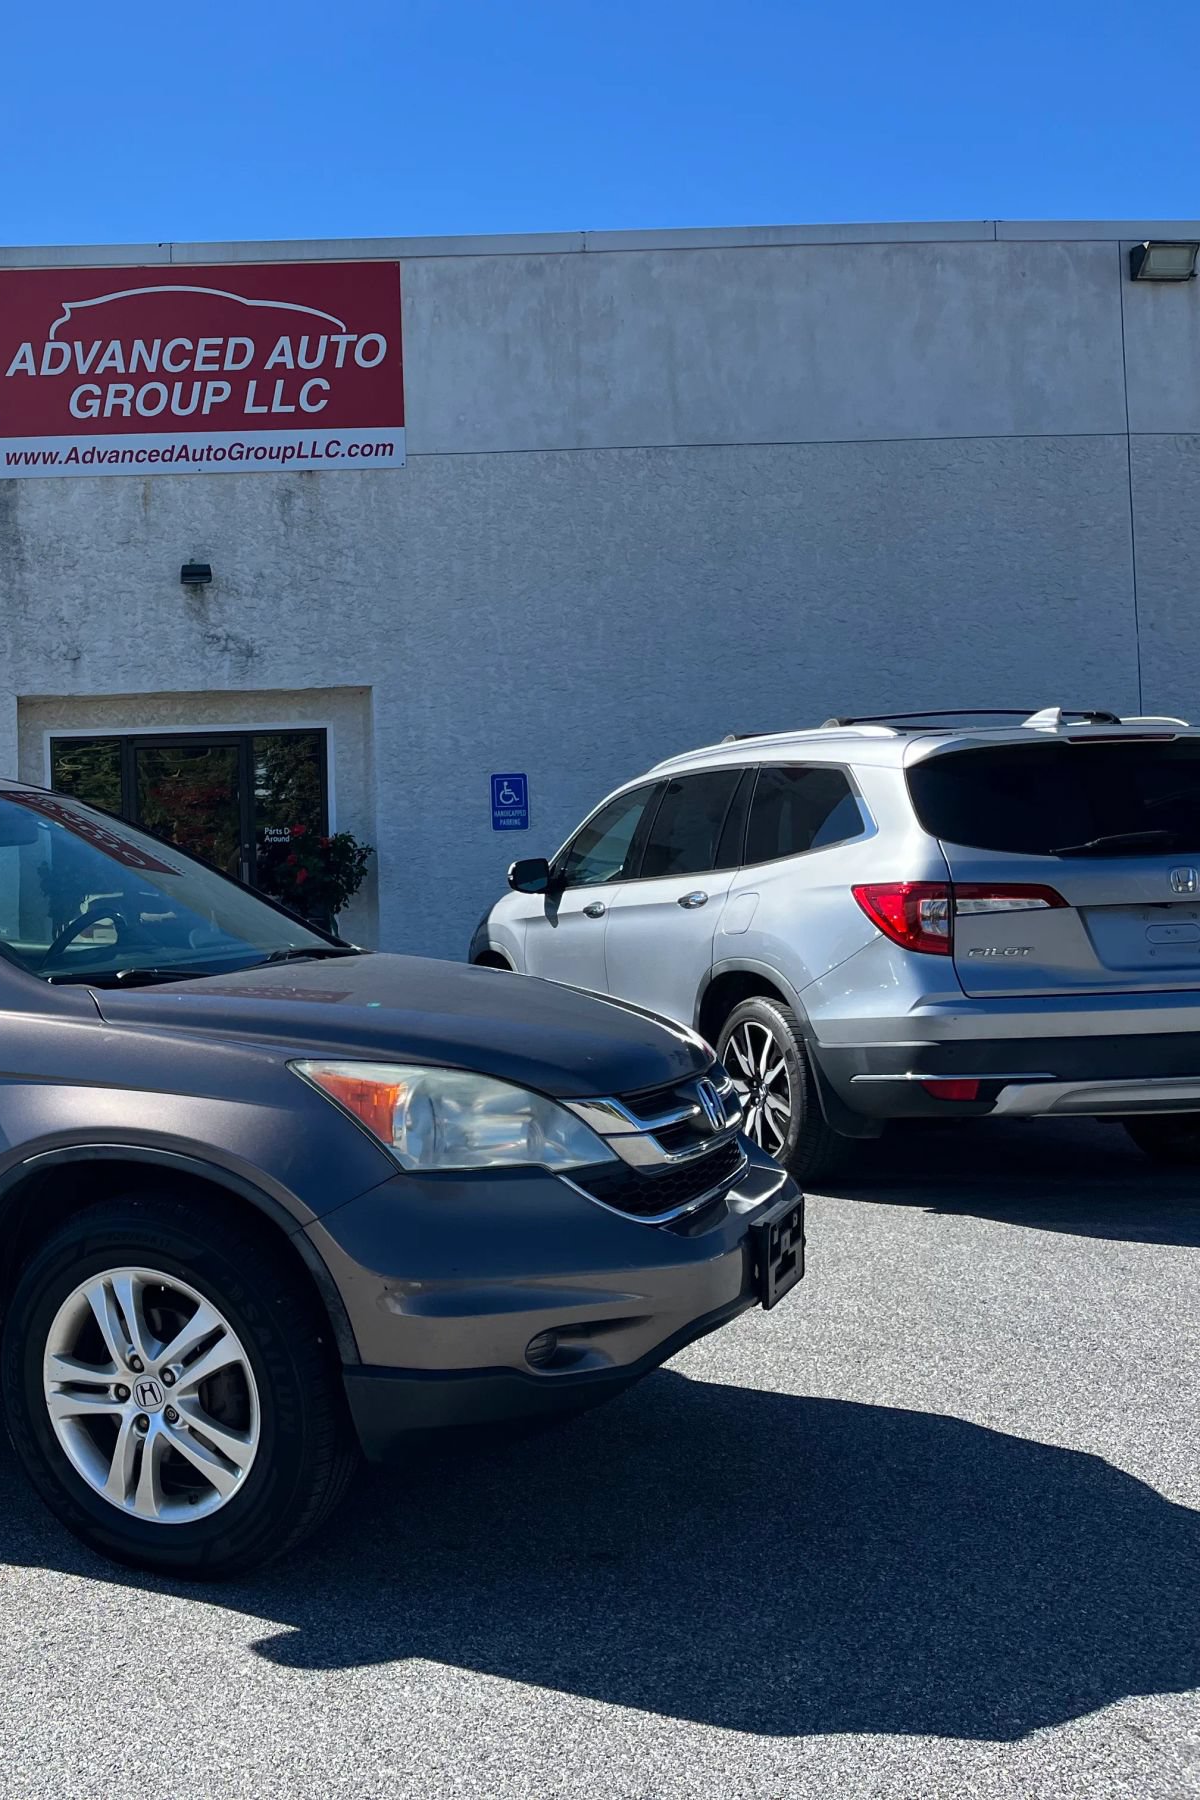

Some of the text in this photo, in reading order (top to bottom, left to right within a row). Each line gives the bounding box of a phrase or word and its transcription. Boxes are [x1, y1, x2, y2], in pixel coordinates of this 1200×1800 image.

[5, 332, 388, 376] ADVANCED AUTO
[68, 377, 331, 418] GROUP LLC
[4, 439, 395, 467] www.AdvancedAutoGroupLLC.com
[499, 818, 521, 826] PARKING
[264, 826, 283, 835] Parts
[264, 835, 290, 843] Around
[968, 946, 1034, 957] PILOT
